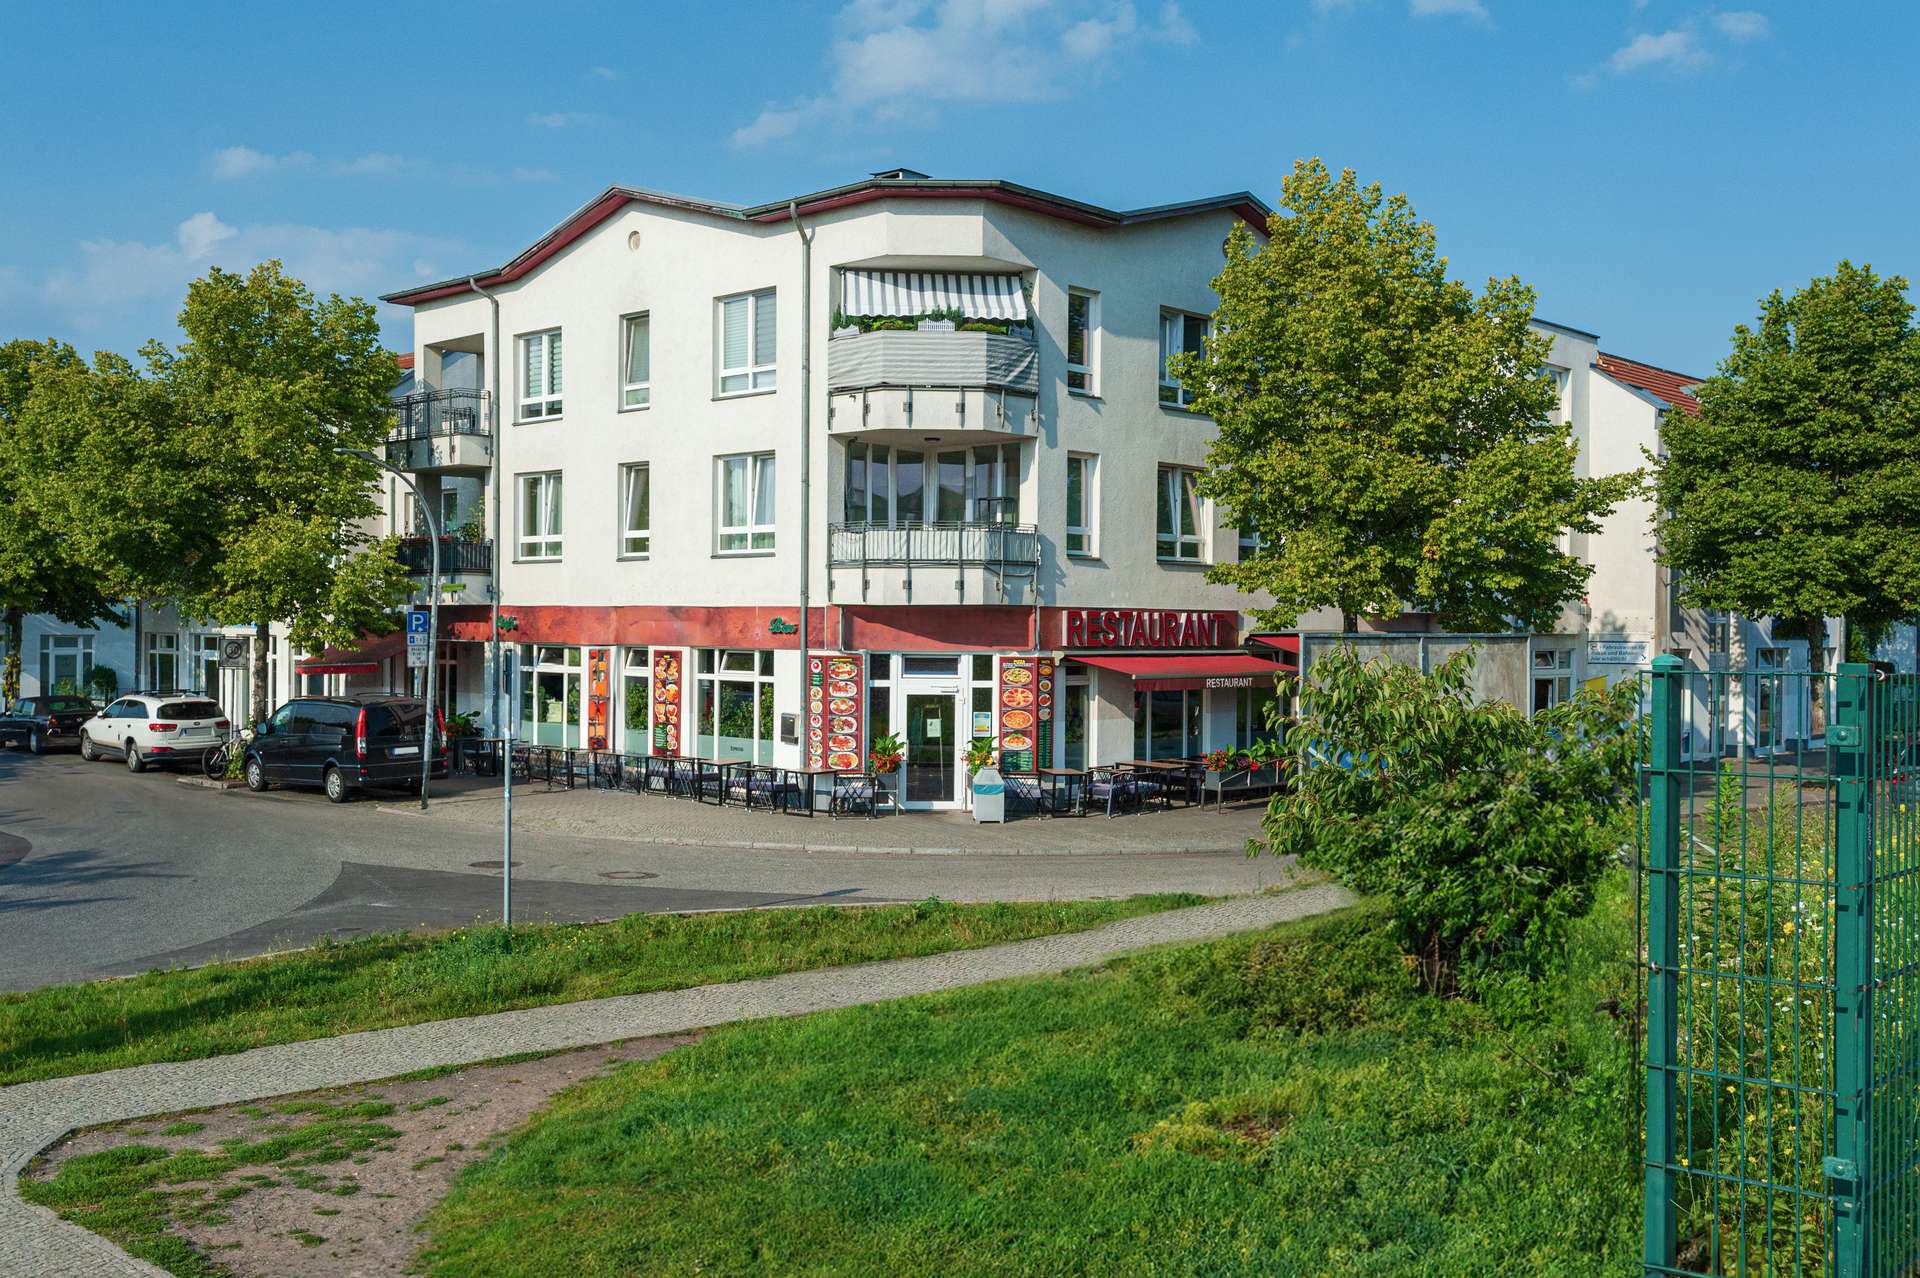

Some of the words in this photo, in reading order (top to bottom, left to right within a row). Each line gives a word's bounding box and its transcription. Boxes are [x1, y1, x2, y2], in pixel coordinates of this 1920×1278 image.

[412, 614, 424, 630] P
[1062, 610, 1226, 648] RESTAURANT
[1206, 677, 1253, 688] RESTAURANT
